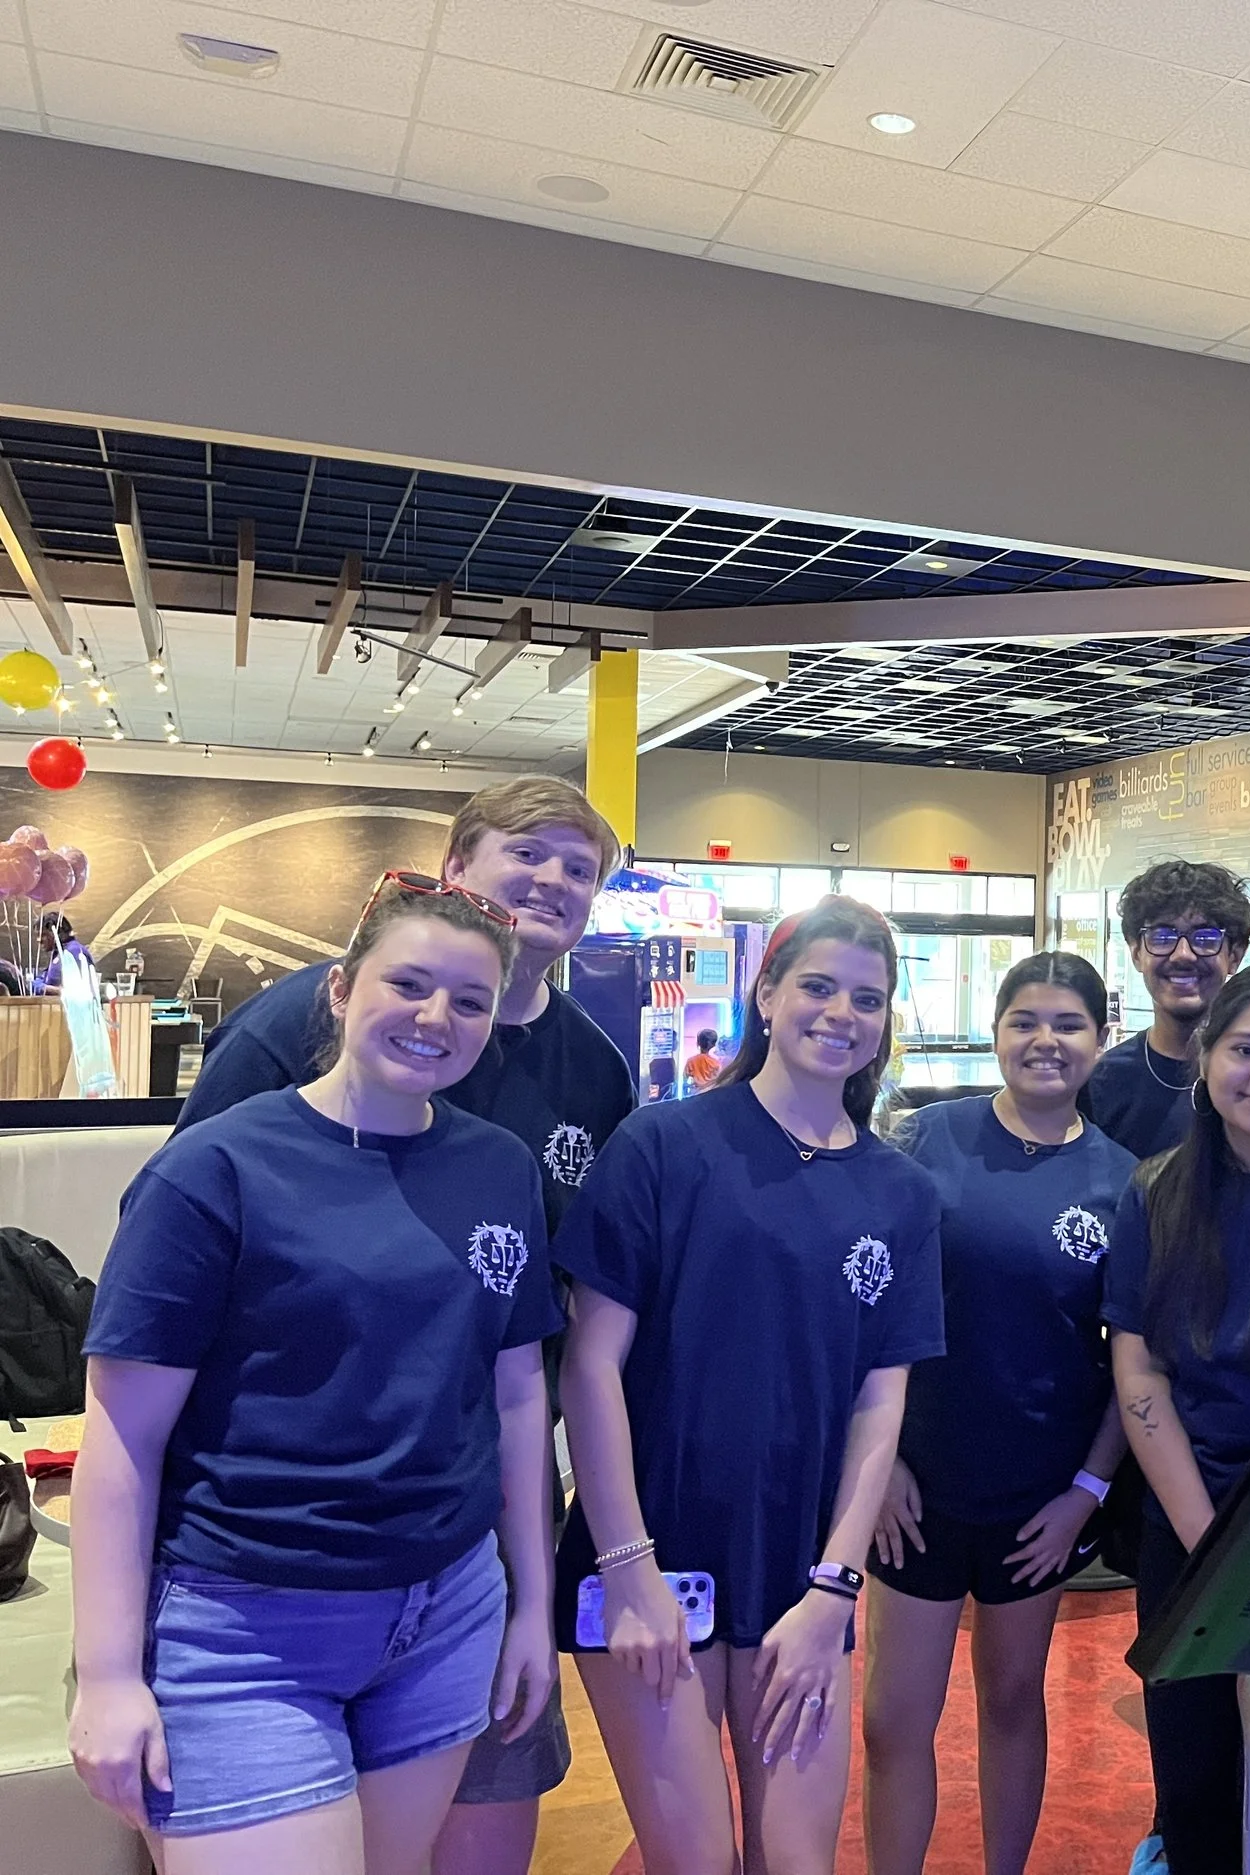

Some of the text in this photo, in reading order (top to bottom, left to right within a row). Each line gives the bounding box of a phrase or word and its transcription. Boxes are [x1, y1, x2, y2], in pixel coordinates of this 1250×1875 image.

[1186, 747, 1204, 776] full
[1092, 771, 1113, 790] video
[1119, 761, 1168, 798] billiards
[1158, 752, 1185, 821] fun
[1209, 776, 1237, 799] group
[1053, 777, 1093, 828] EAT.
[1091, 788, 1118, 808] games
[1121, 795, 1159, 816] craveable
[1186, 782, 1207, 808] bar
[1208, 799, 1237, 815] events
[1121, 815, 1143, 830] treats
